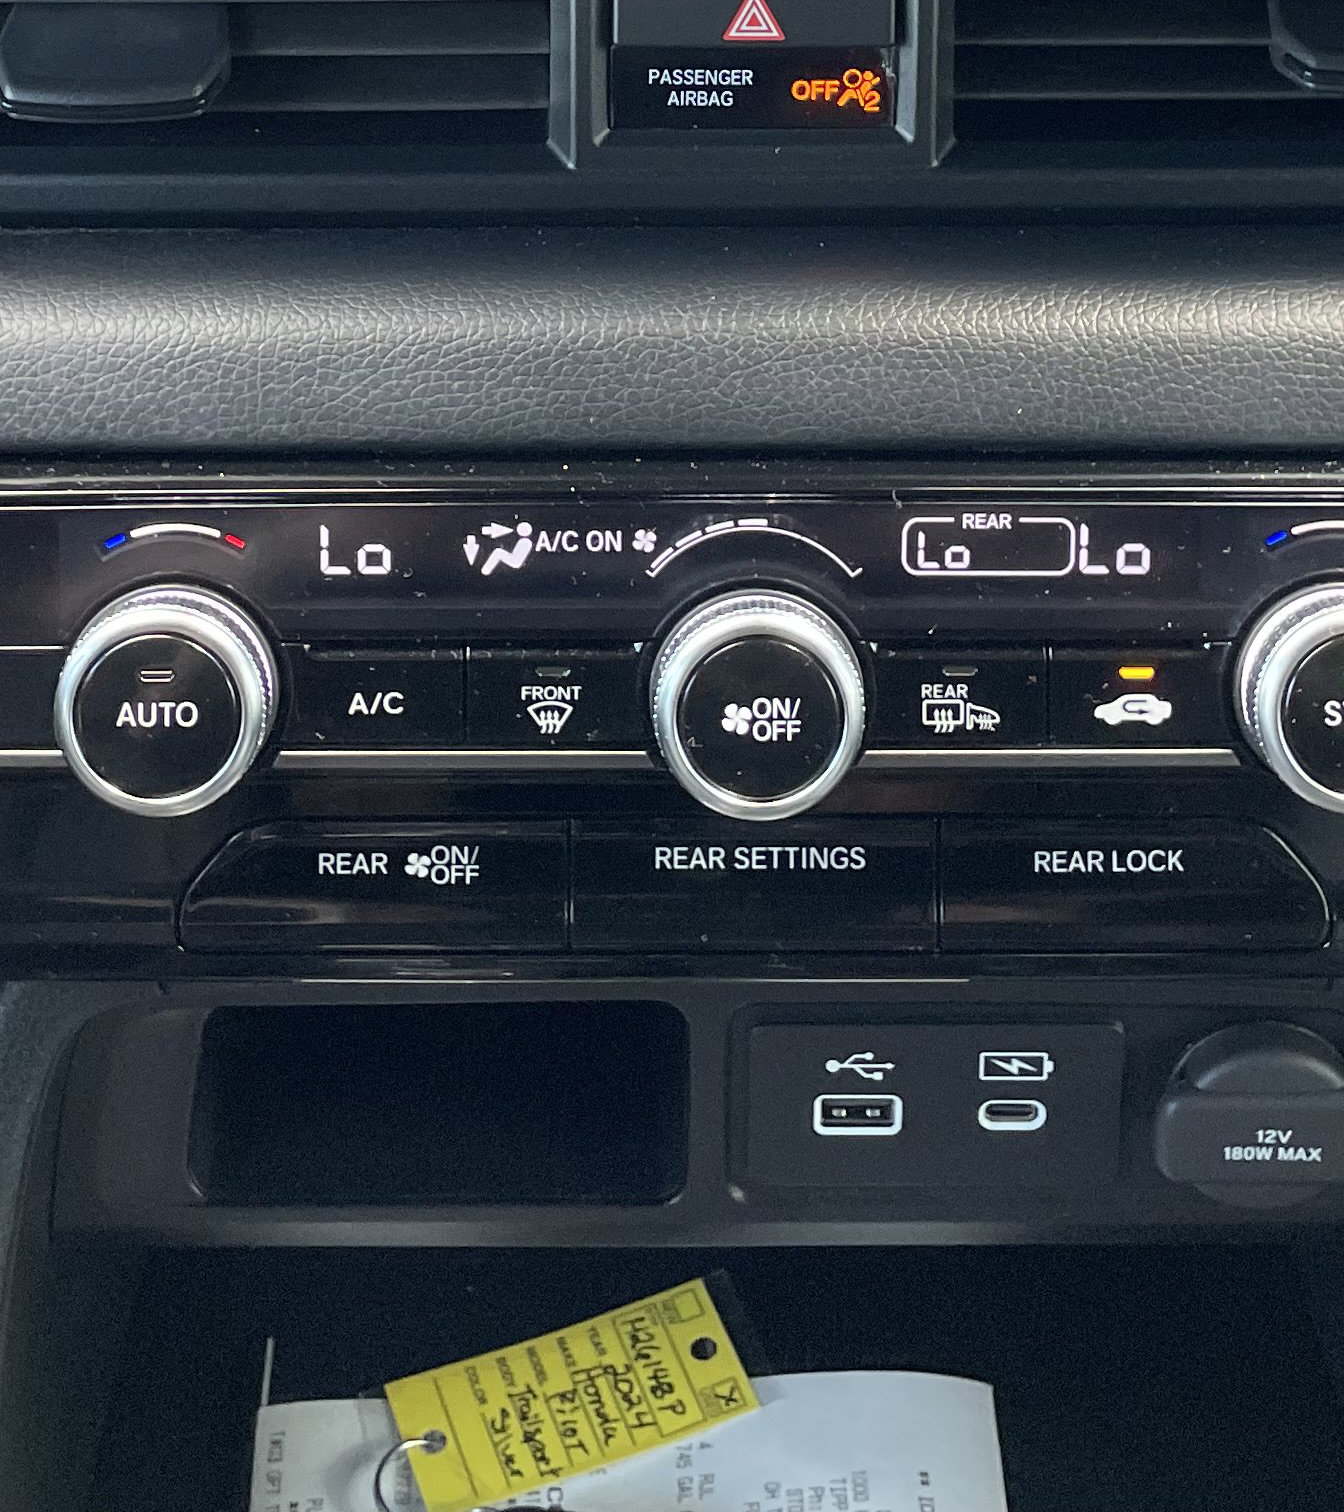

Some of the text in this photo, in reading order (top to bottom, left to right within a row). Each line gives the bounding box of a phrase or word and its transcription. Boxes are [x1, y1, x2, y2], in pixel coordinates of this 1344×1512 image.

[648, 68, 753, 86] PASSENGER
[667, 90, 734, 107] AIRBAG
[790, 78, 841, 102] OFF
[962, 513, 1012, 529] REAR
[319, 524, 392, 576] Lo
[534, 530, 623, 554] A/C ON
[916, 530, 971, 570] Lo
[1078, 523, 1152, 575] Lo
[348, 691, 404, 716] A/C
[520, 684, 582, 701] FRONT
[920, 683, 969, 700] REAR
[115, 701, 199, 728] AUTO
[752, 696, 801, 720] ON/
[752, 719, 802, 742] OFF
[317, 844, 480, 875] REAR ON/
[654, 846, 866, 870] REAR SETTINGS
[1033, 849, 1184, 874] REAR LOCK
[431, 864, 480, 885] OFF
[1255, 1128, 1292, 1144] 12V
[1222, 1145, 1323, 1163] 180W MAX
[570, 1364, 620, 1448] Honda
[599, 1362, 658, 1429] 2024
